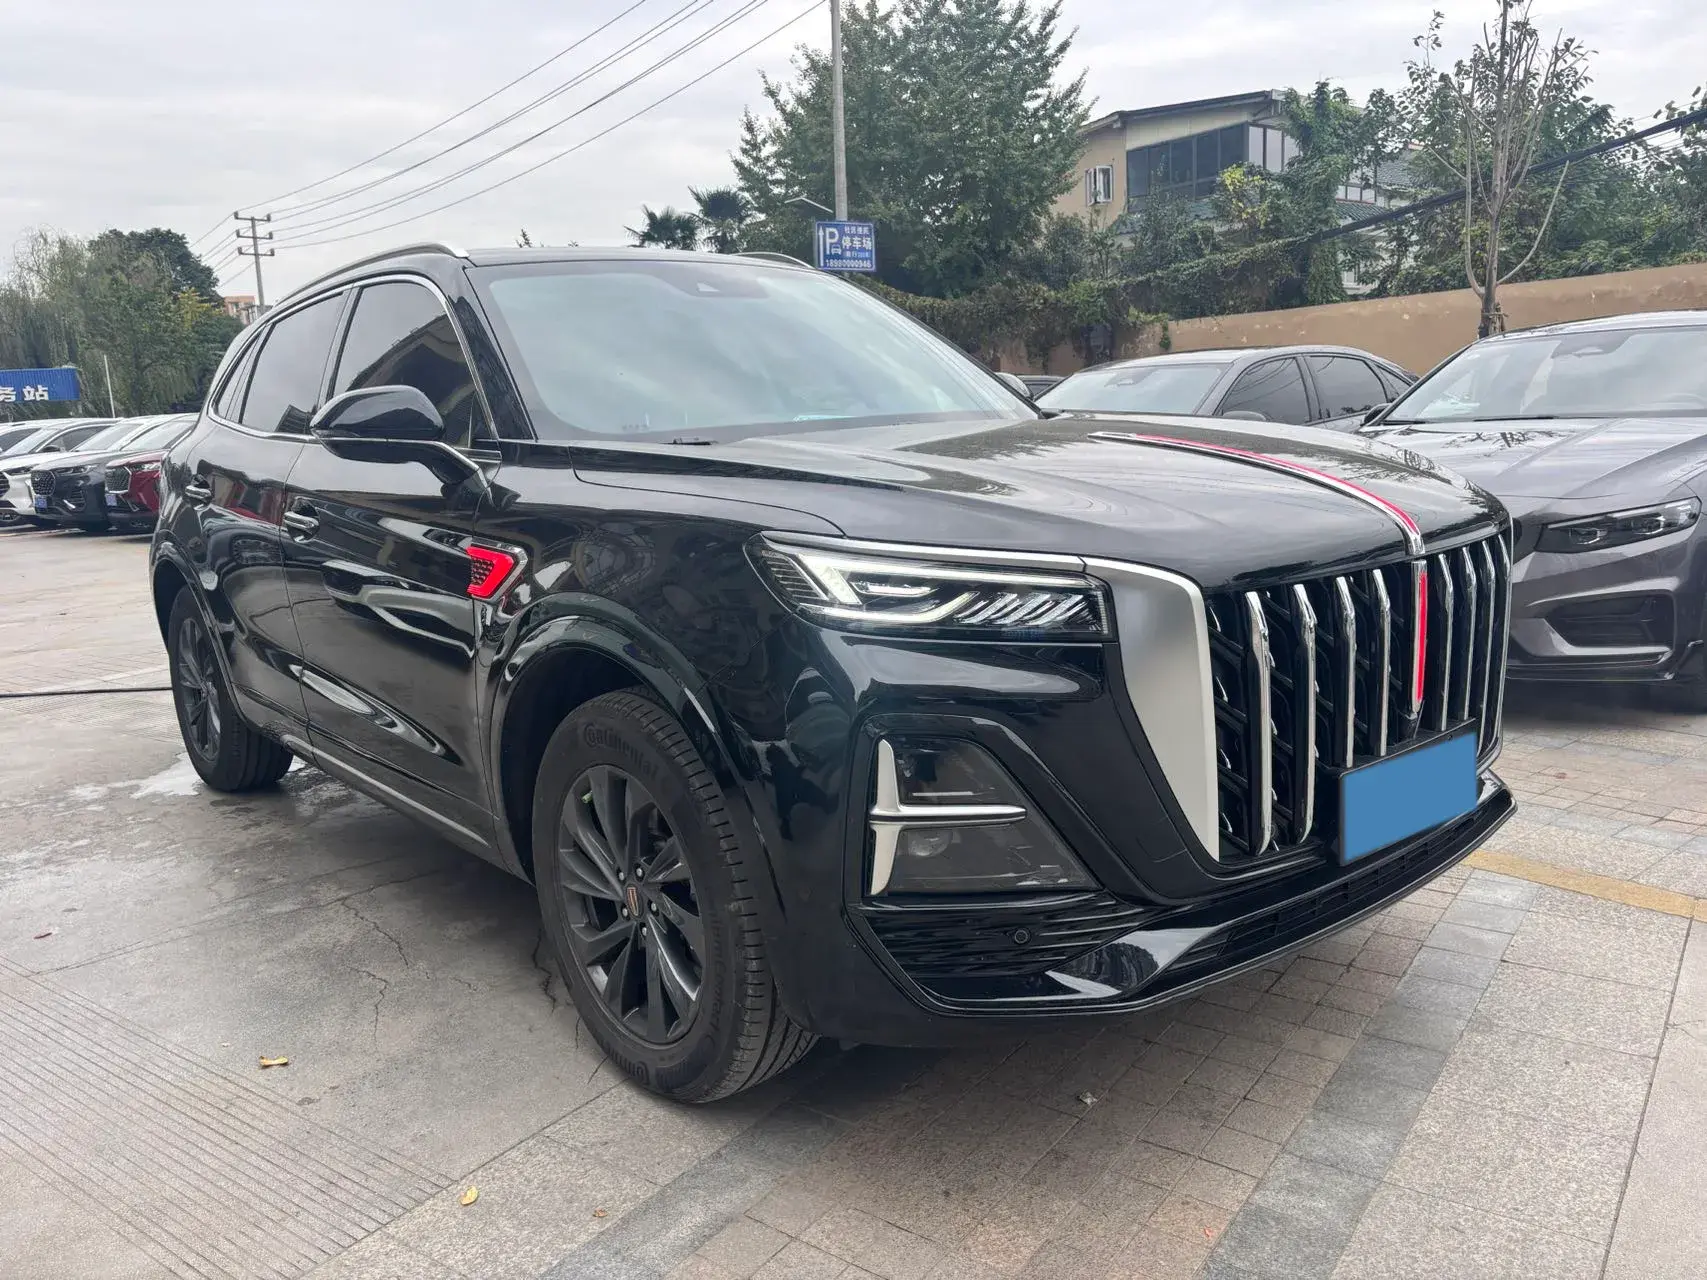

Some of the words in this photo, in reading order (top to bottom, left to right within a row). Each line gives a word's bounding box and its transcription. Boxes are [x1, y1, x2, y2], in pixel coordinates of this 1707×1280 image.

[825, 227, 839, 255] P
[842, 236, 872, 250] 停车场
[583, 722, 659, 782] Continental
